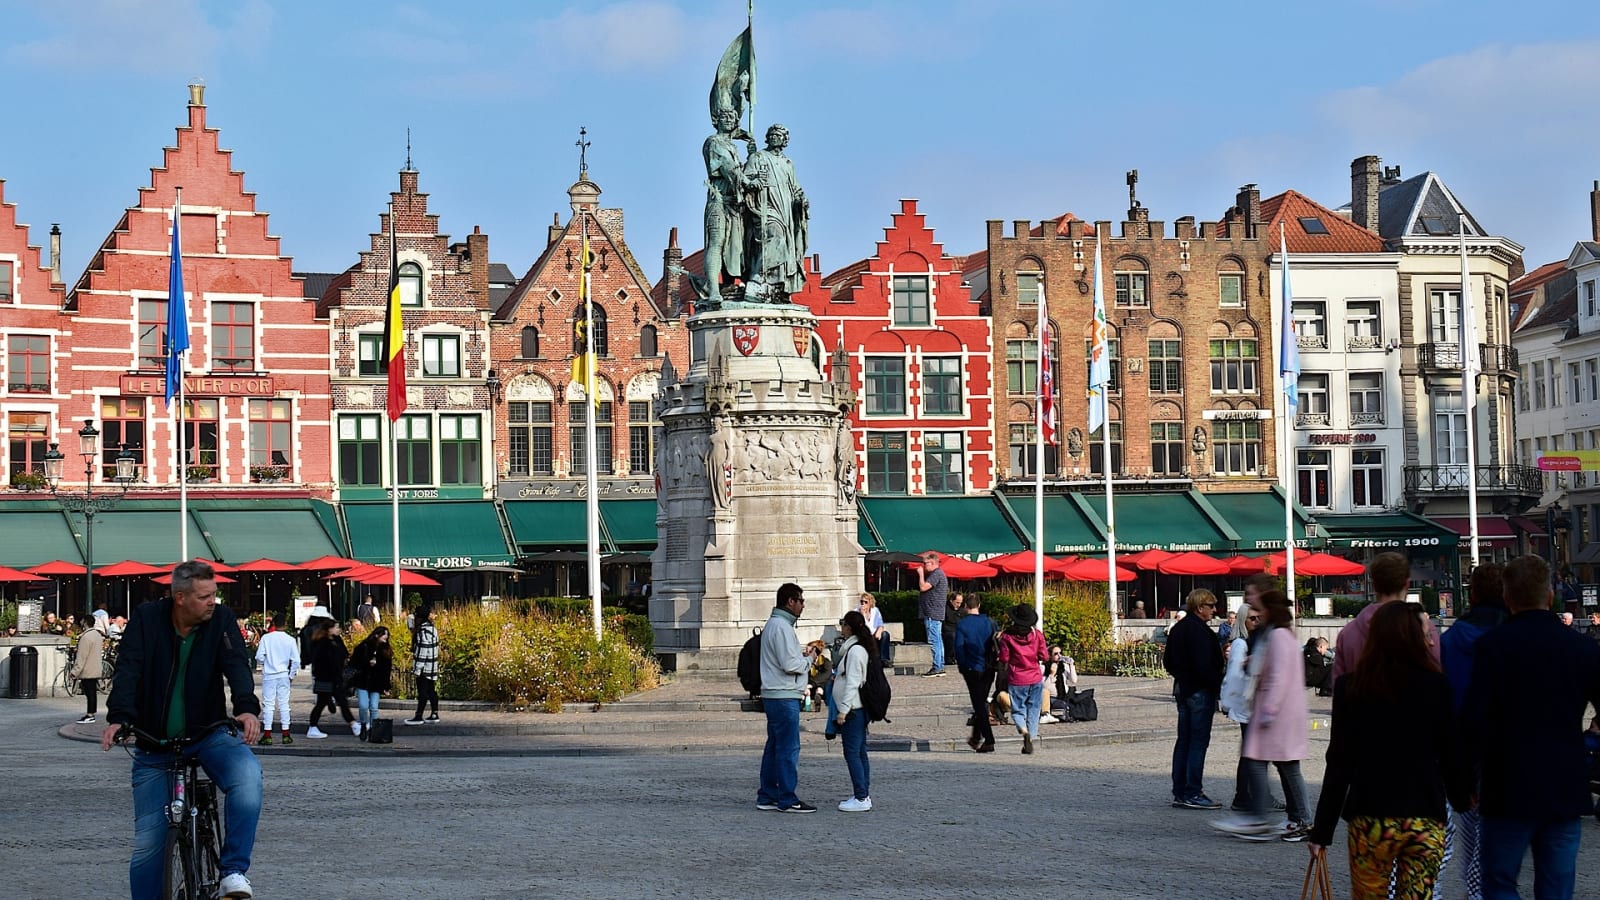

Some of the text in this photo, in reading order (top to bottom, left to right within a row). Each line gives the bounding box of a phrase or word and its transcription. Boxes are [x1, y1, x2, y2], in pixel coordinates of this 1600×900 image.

[127, 379, 150, 393] LE
[154, 378, 223, 393] PNIER
[386, 489, 439, 499] SNT JORIS
[1055, 543, 1096, 552] Brasserie
[1169, 542, 1211, 551] Restaurant
[1254, 540, 1282, 549] PETIT
[1350, 537, 1439, 548] Friterie 1900
[399, 556, 473, 568] SINT-JORIS
